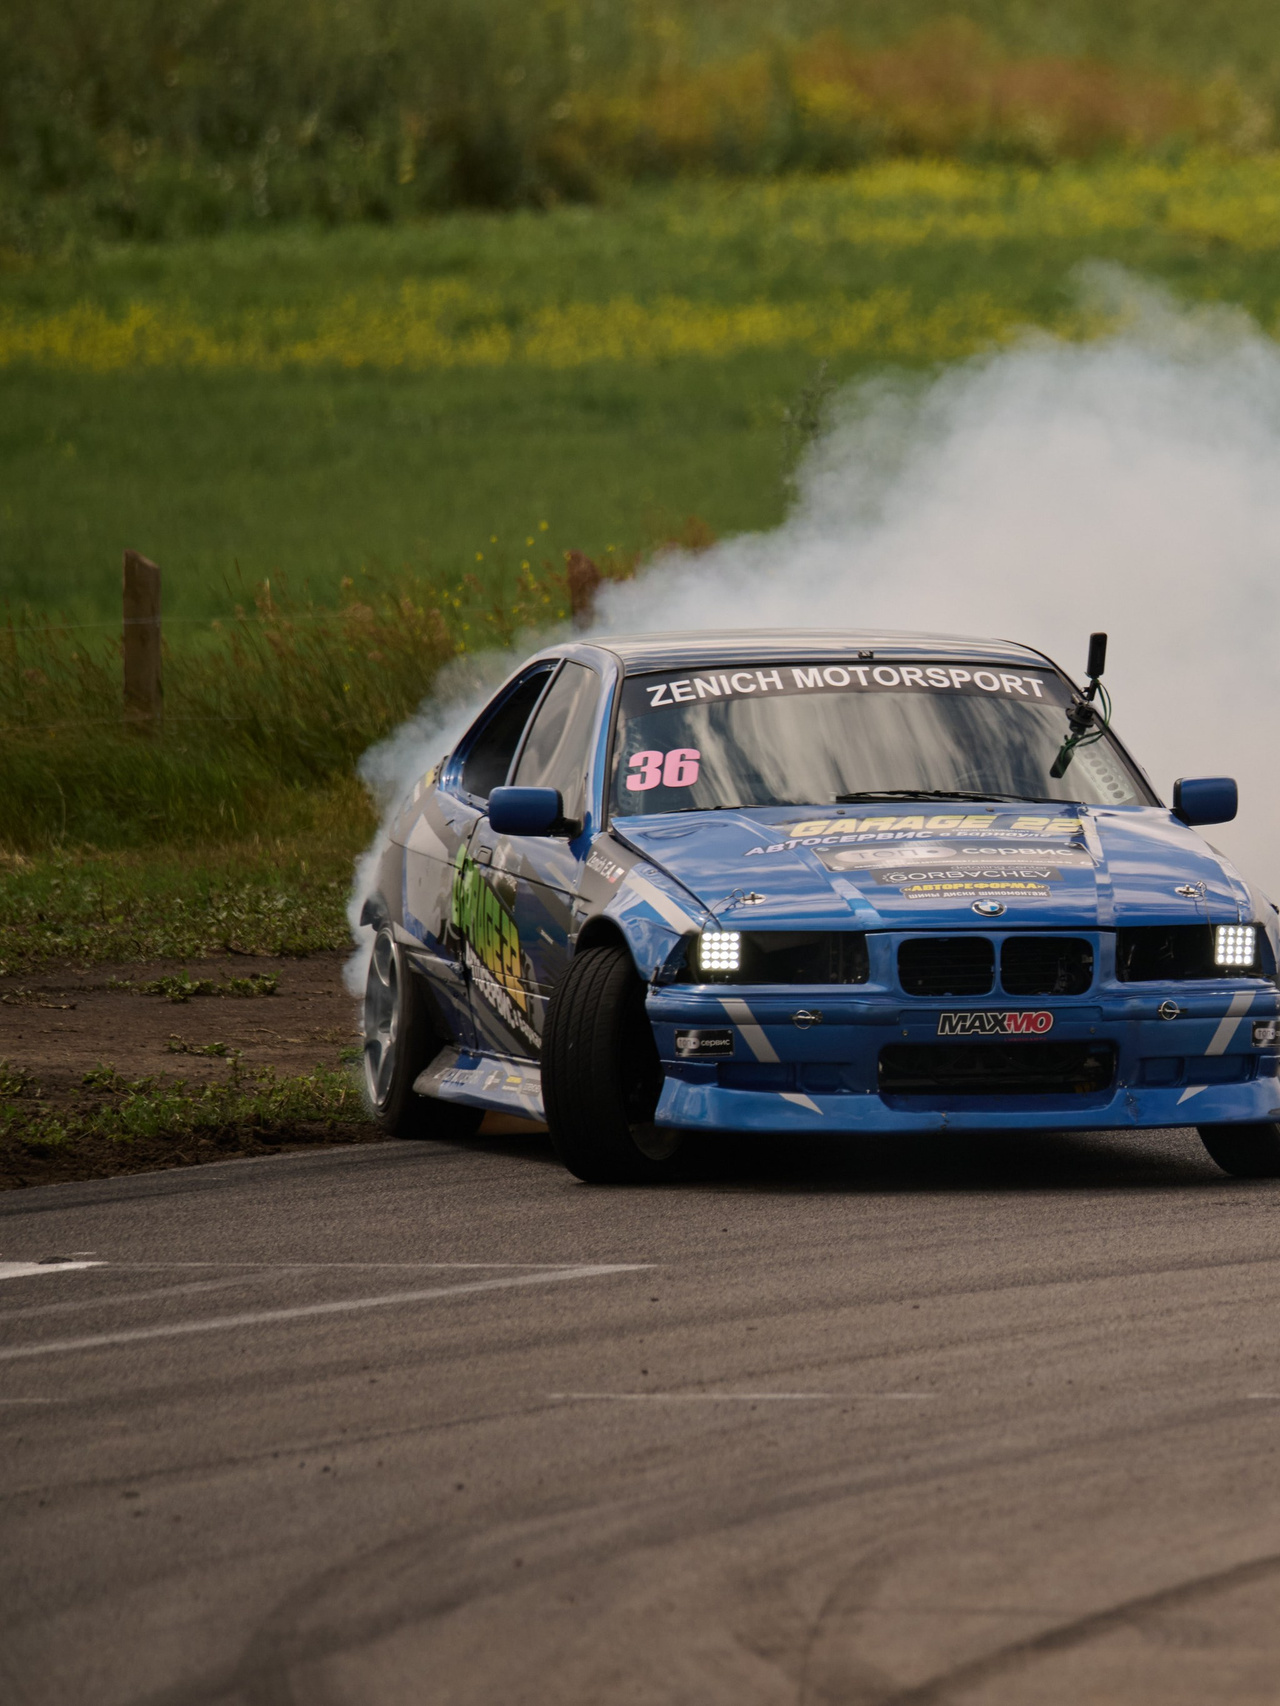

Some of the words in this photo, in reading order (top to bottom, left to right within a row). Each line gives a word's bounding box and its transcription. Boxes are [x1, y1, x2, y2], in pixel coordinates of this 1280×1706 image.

[646, 669, 784, 707] ZENICH
[791, 666, 1044, 698] MOTORSPORT
[626, 748, 701, 791] 36
[789, 814, 998, 838] GARAGE
[1009, 816, 1085, 832] 22
[744, 828, 934, 857] АВТОСЕРВИС
[961, 847, 1074, 856] сервис
[938, 1011, 1054, 1035] MAXMO
[700, 1039, 731, 1047] сервис
